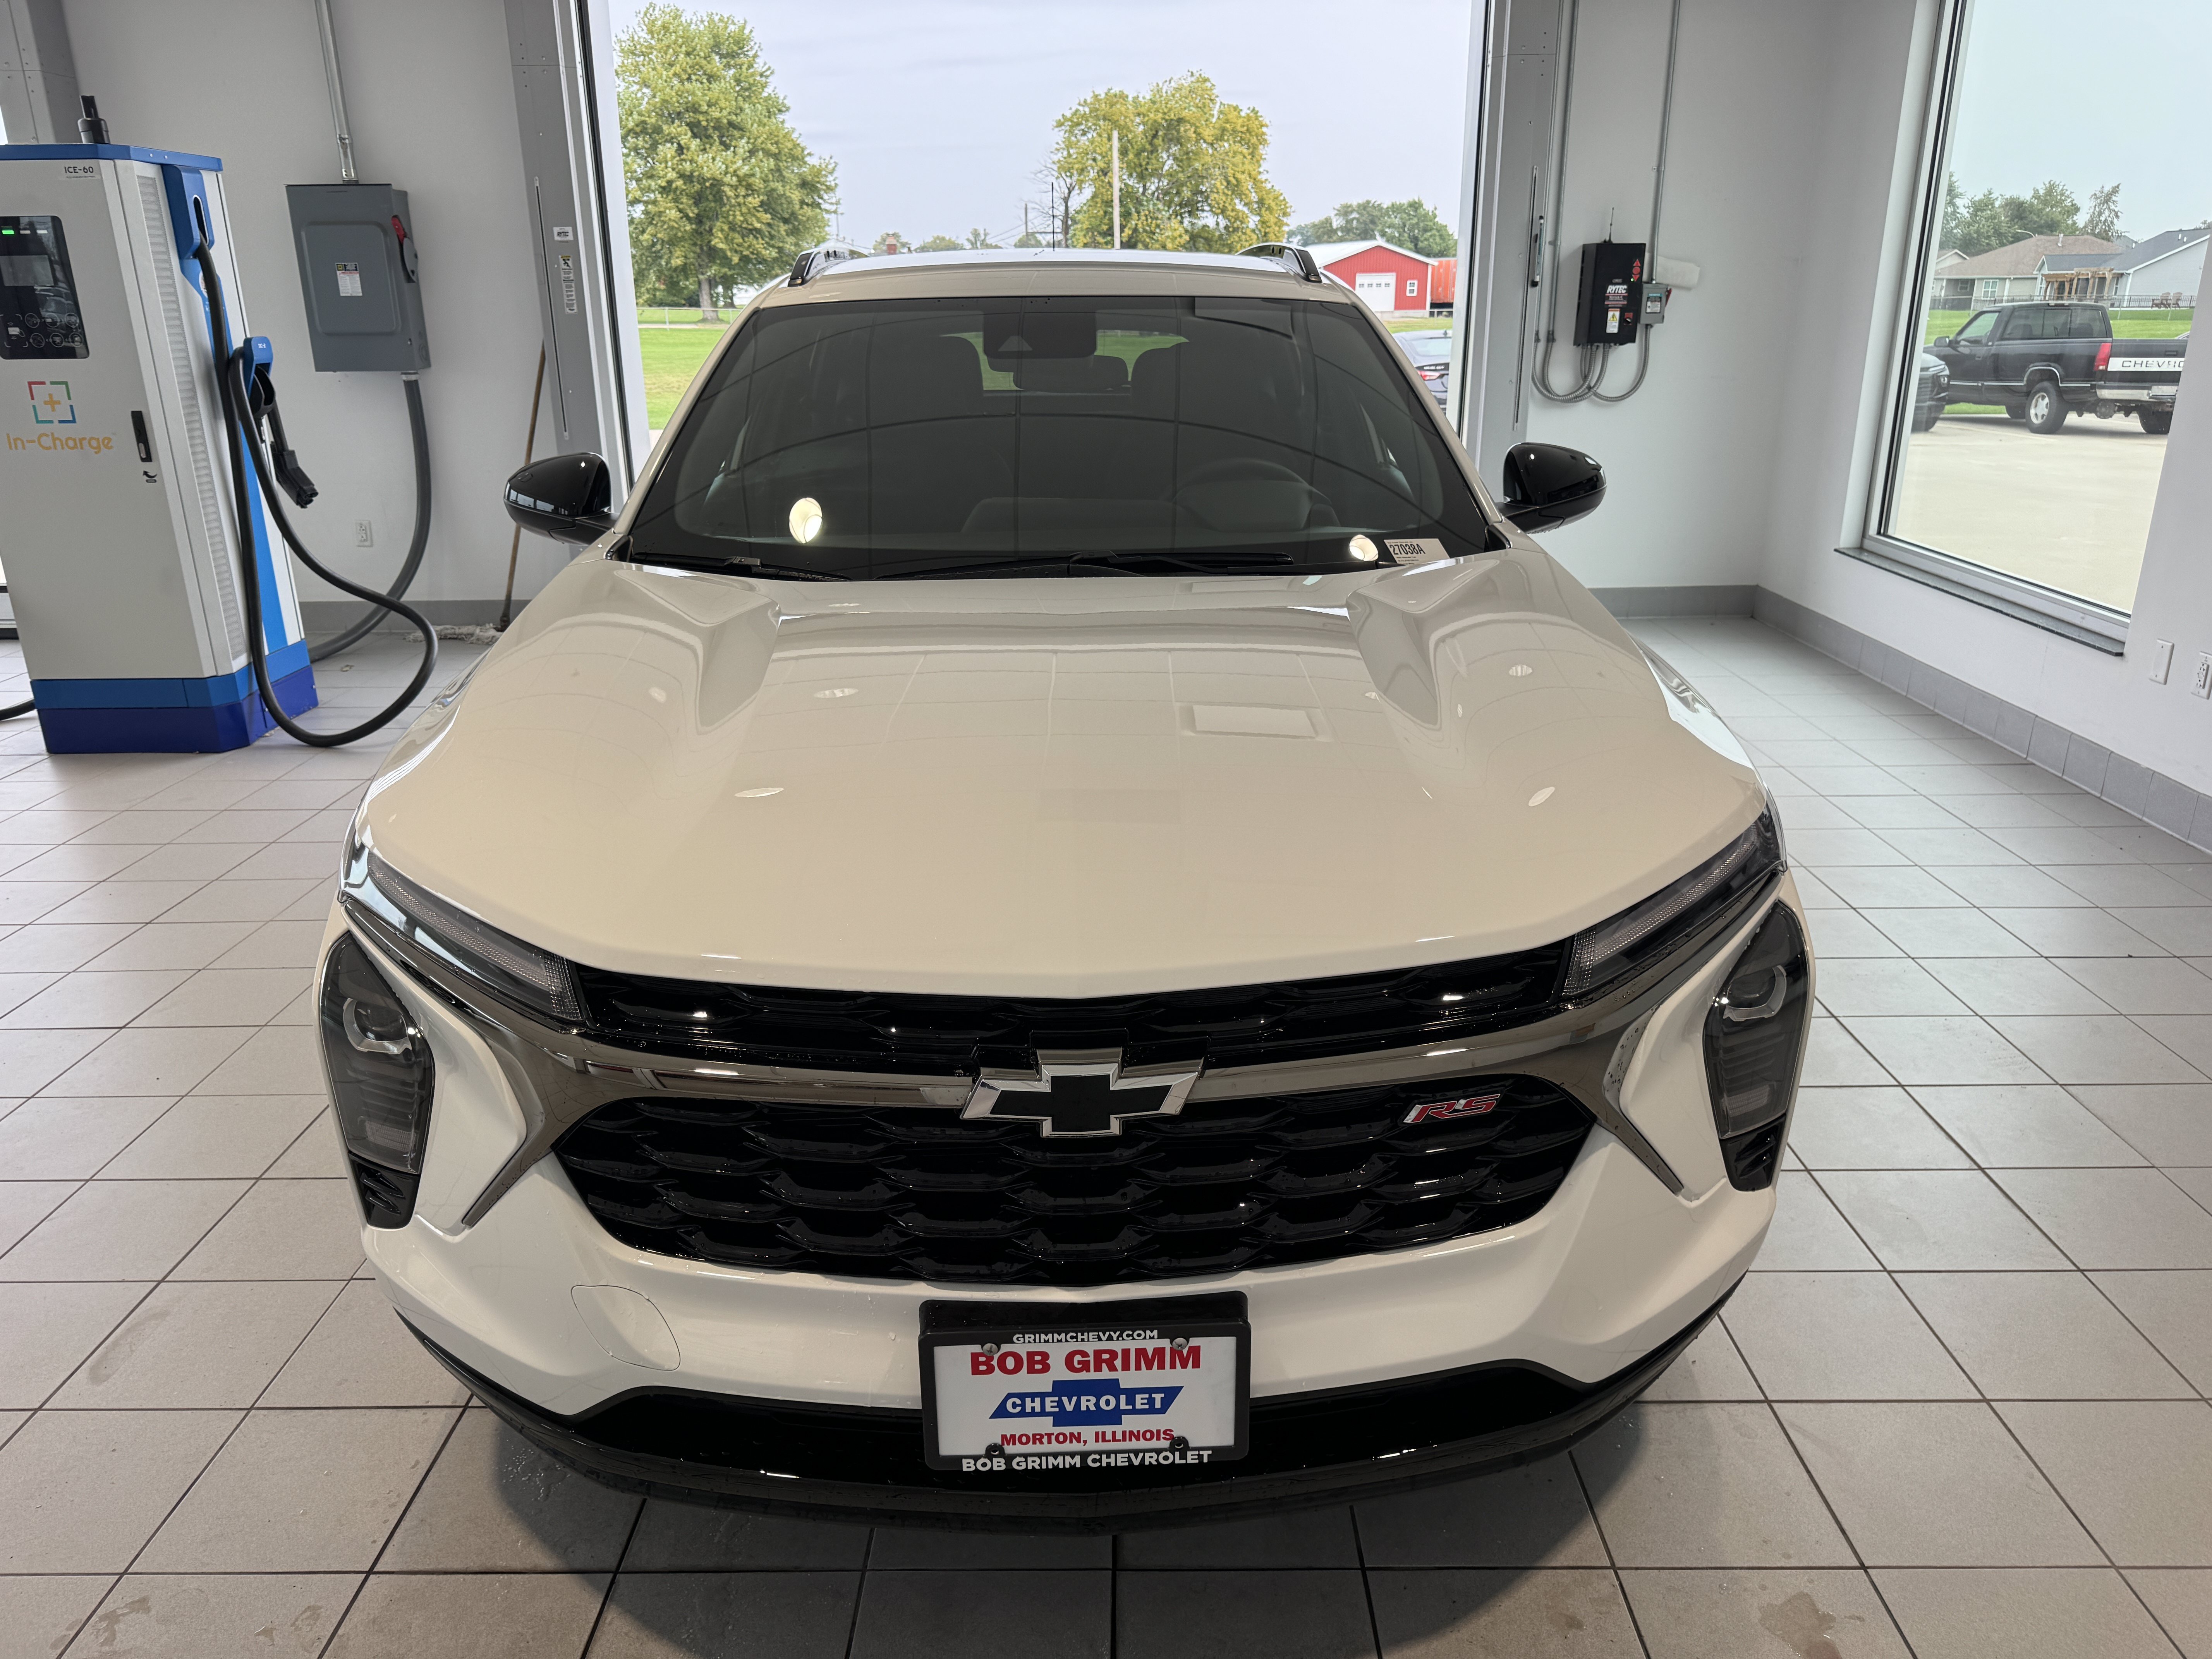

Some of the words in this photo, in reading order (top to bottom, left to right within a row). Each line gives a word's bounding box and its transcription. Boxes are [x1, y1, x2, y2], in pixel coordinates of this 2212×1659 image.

[1606, 285, 1628, 294] RYTEC
[6, 432, 113, 455] In-Charge
[1389, 544, 1425, 555] 27038A
[1403, 1093, 1501, 1123] RS
[1013, 1330, 1158, 1344] GRIMMCHEVY.COM
[970, 1350, 1051, 1376] BOB
[1064, 1345, 1201, 1374] GRIMM
[1006, 1393, 1165, 1413] CHEVROLET
[1000, 1431, 1087, 1446] MORTON,
[1094, 1428, 1175, 1443] ILLINOIS
[962, 1457, 1007, 1472] BOB
[1012, 1454, 1081, 1470] GRIMM
[1087, 1450, 1212, 1468] CHEVROLET
